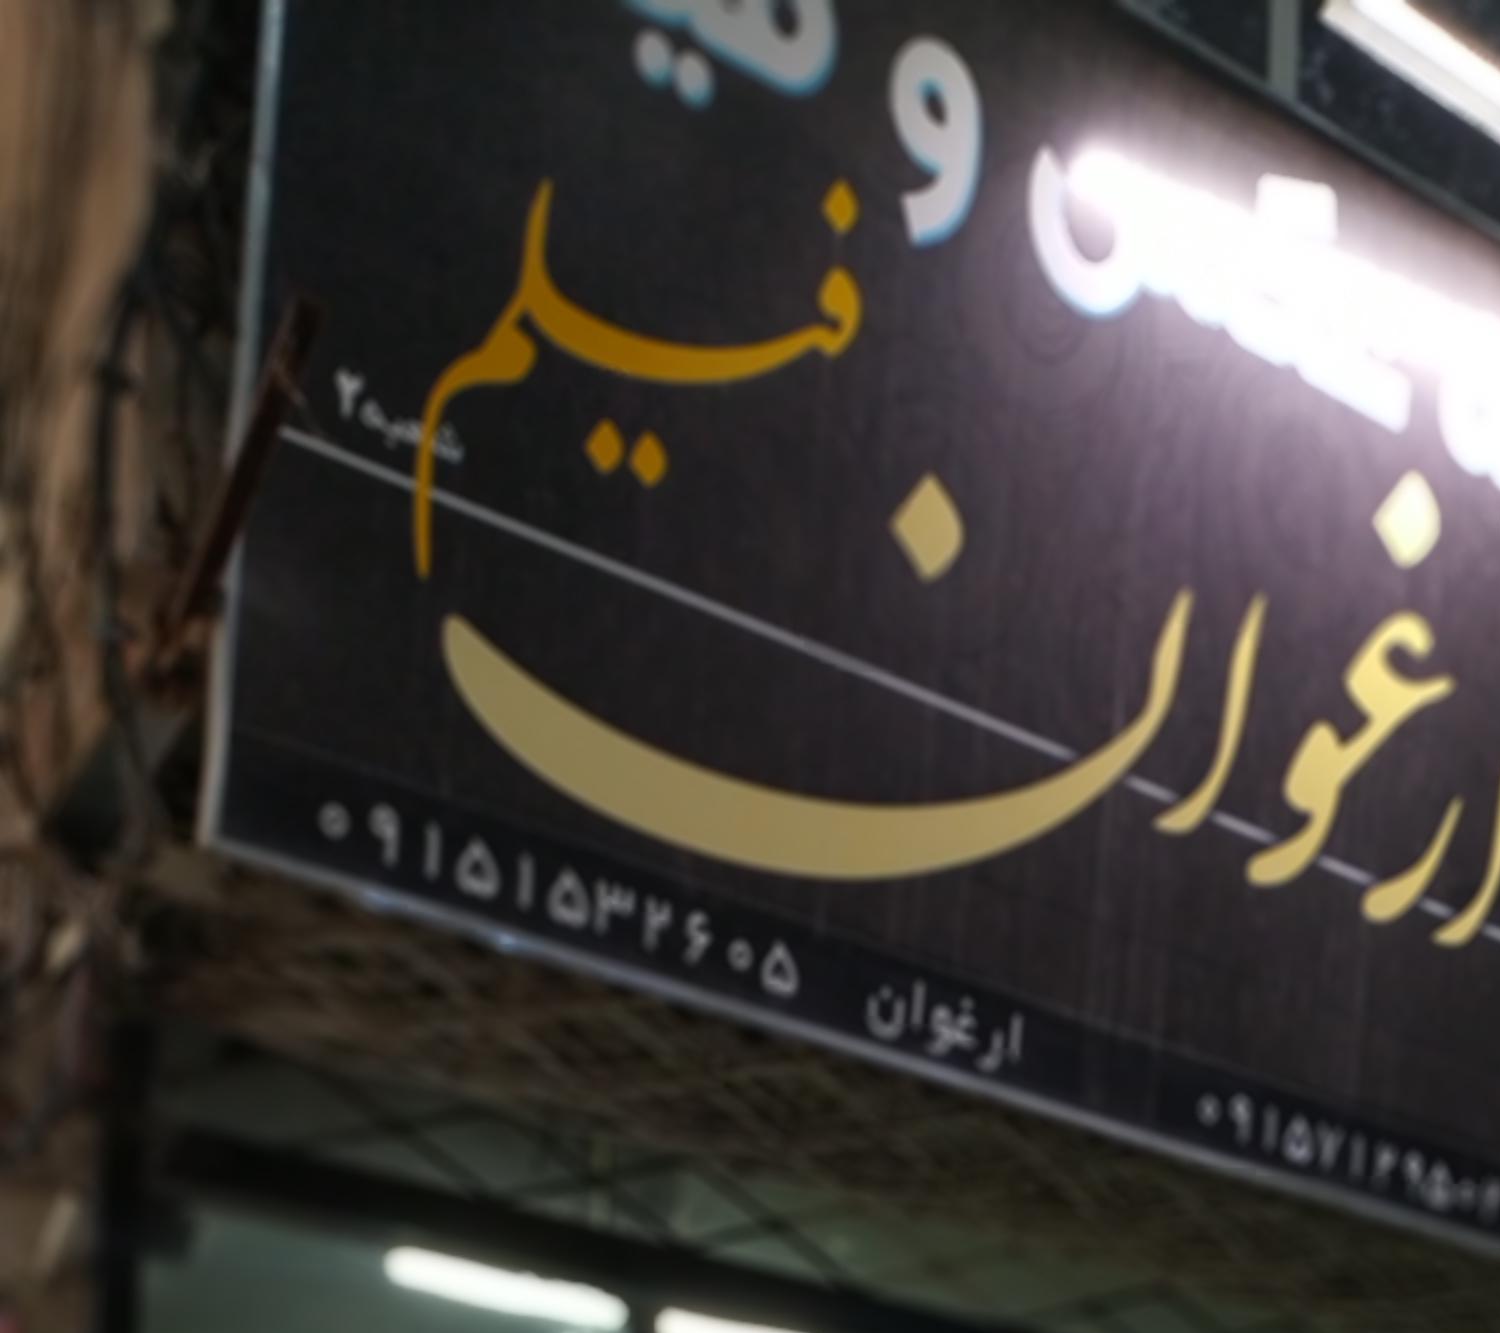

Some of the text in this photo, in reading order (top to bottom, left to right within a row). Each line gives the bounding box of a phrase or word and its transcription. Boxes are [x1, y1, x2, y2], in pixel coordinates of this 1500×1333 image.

[888, 36, 983, 247] و
[412, 177, 863, 582] فیلم
[864, 978, 1025, 1074] ارغوان
